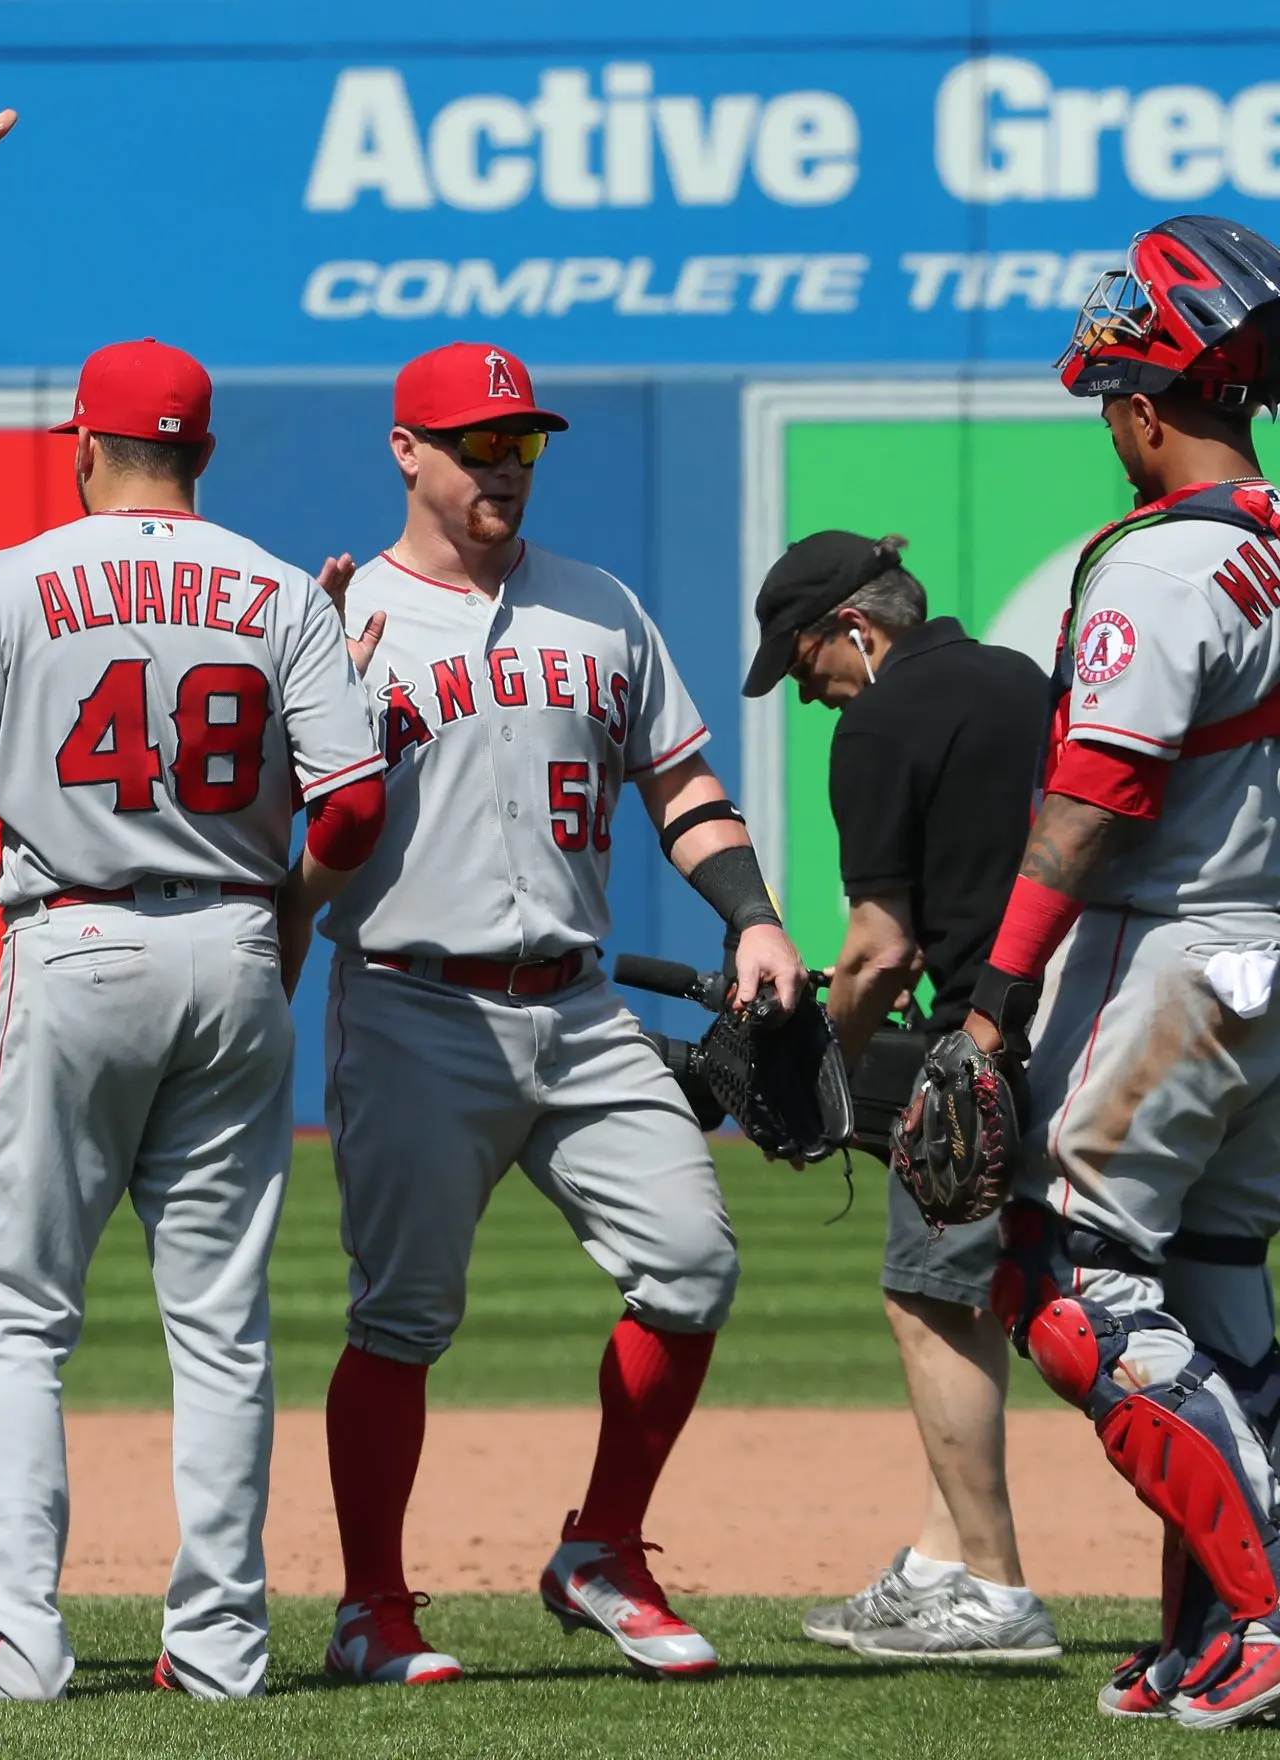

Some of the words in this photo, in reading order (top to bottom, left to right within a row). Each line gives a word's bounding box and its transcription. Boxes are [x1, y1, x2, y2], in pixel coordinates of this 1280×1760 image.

[304, 62, 860, 213] Active
[302, 253, 868, 319] COMPLETE
[484, 350, 520, 398] A
[35, 559, 279, 639] ALVAREZ
[55, 658, 272, 814] 48
[376, 647, 629, 776] ANGELS
